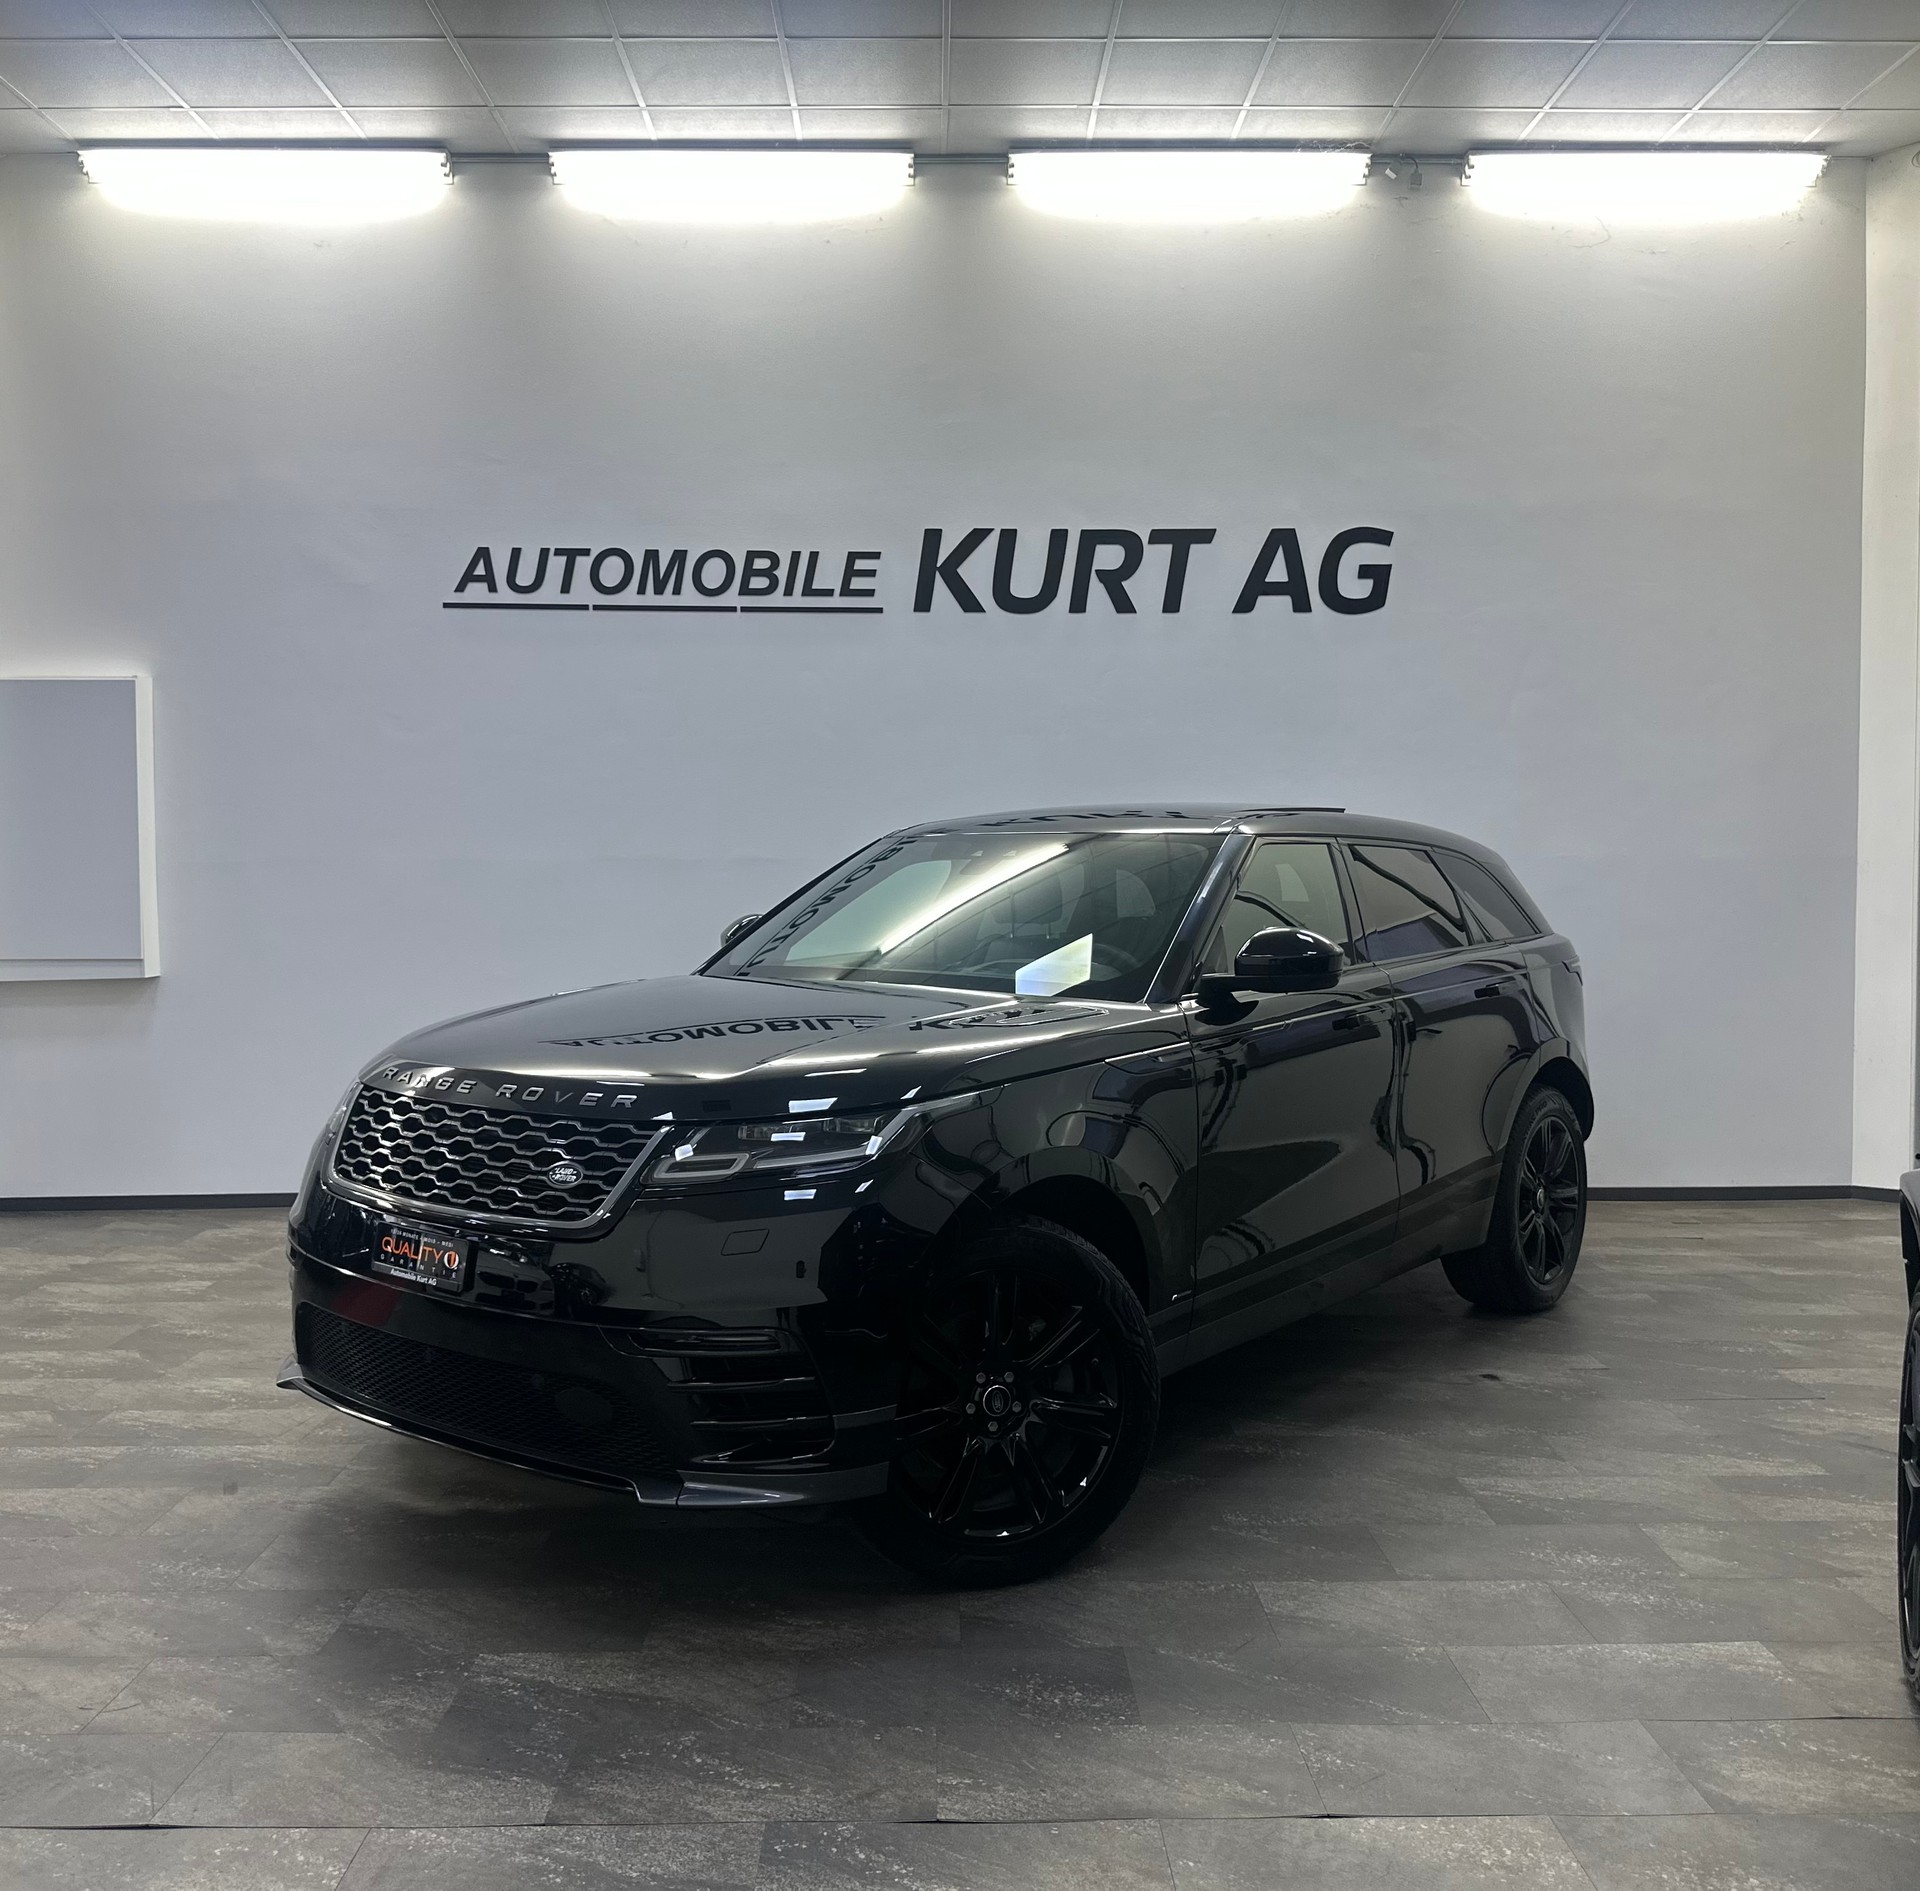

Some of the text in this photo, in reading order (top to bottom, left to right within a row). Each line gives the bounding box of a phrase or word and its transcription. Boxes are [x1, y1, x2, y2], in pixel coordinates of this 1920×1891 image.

[453, 526, 1394, 615] AUTOMOBILE KURT AG
[383, 1066, 638, 1109] RANGE ROVER
[380, 1253, 457, 1279] GARANTIE
[381, 1236, 443, 1267] QUALITY
[390, 1267, 437, 1286] Automobile Kurt AG
